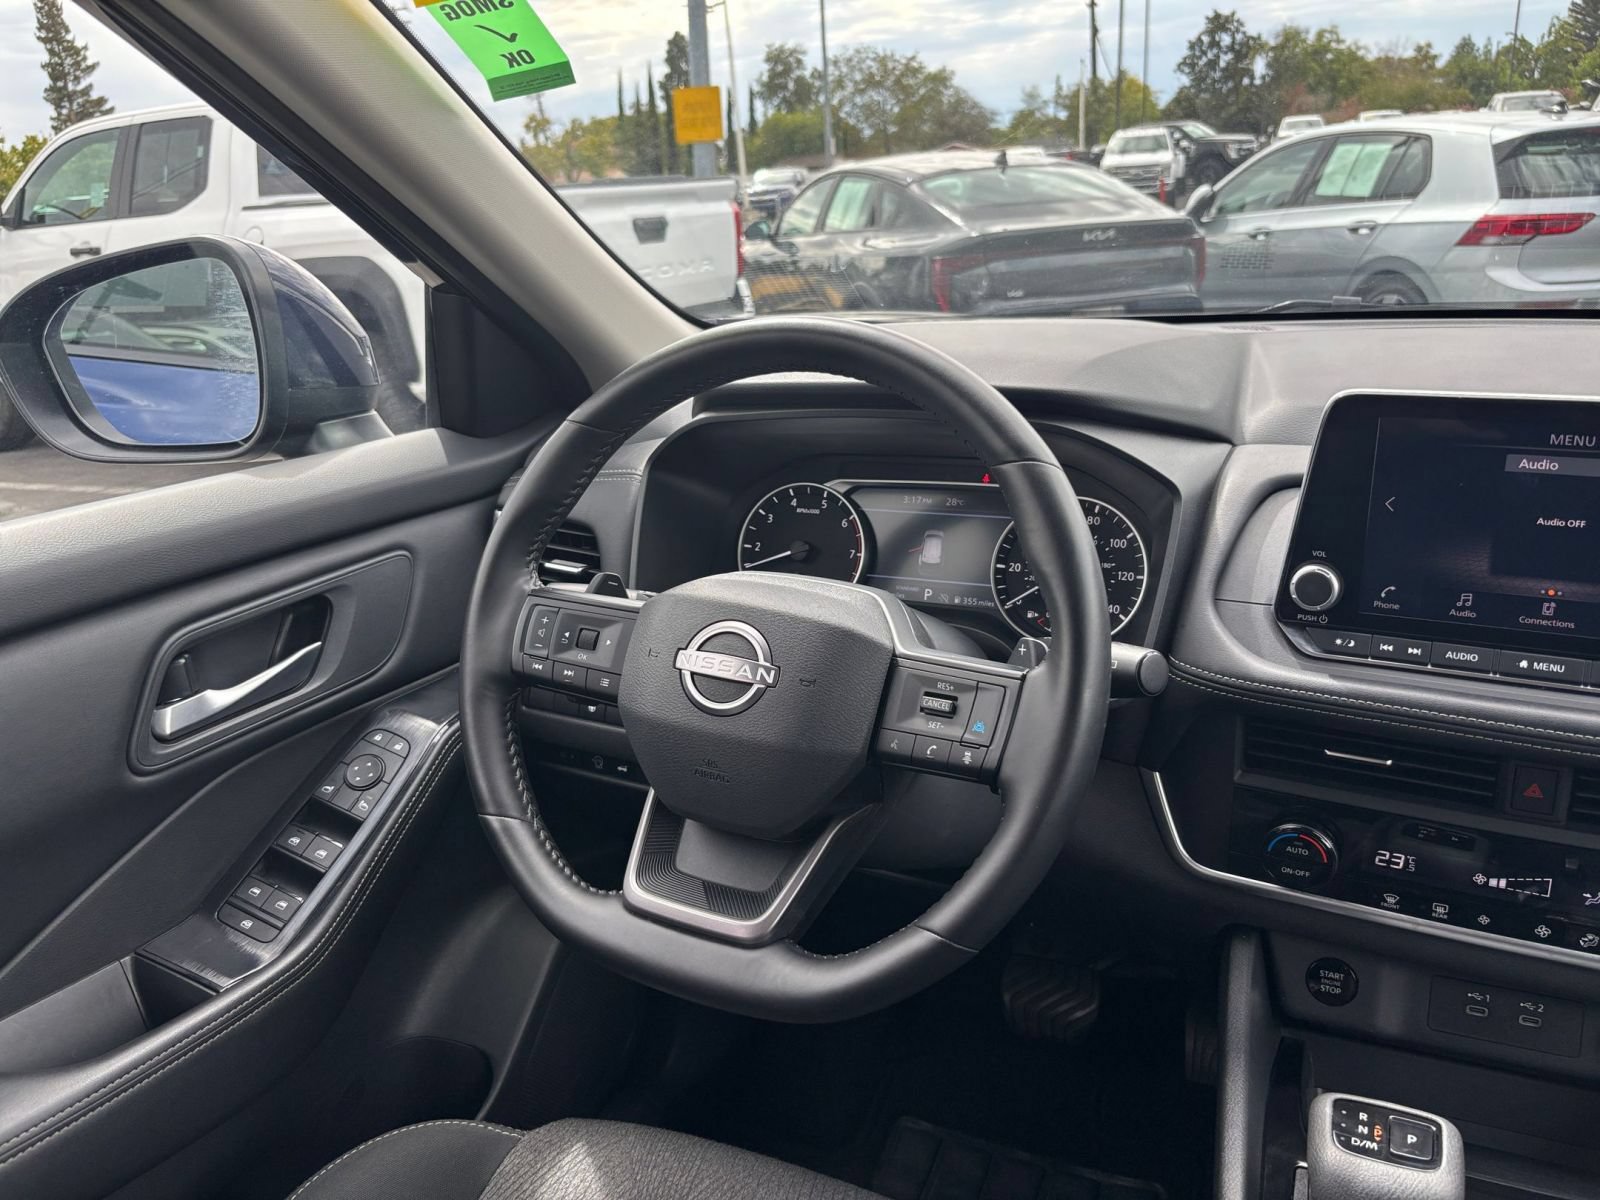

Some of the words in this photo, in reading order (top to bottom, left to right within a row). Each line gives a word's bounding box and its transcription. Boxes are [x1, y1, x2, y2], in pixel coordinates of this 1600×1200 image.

[1549, 433, 1596, 447] MENU
[1518, 458, 1560, 471] Audio
[790, 498, 797, 507] 4
[821, 499, 828, 509] 5
[767, 513, 774, 523] 3
[841, 518, 848, 528] 6
[1087, 515, 1101, 526] 80
[1536, 517, 1566, 527] Audio
[1567, 519, 1587, 528] OFF
[754, 542, 761, 552] 2
[1110, 538, 1128, 549] 100
[849, 549, 856, 559] 7
[1008, 562, 1021, 572] 20
[1118, 571, 1135, 582] 120
[924, 588, 933, 601] P
[1373, 600, 1400, 610] Phone
[1297, 613, 1318, 622] PUSH
[1449, 608, 1477, 618] Audio
[1518, 616, 1575, 629] Connections
[1445, 650, 1479, 662] AUDIO
[678, 651, 776, 684] NISSAN
[1533, 661, 1565, 673] MENU
[922, 698, 950, 712] CANCEL
[1286, 846, 1309, 856] AUTO
[1281, 866, 1311, 878] ON-OFF
[1320, 969, 1345, 981] START
[1320, 984, 1342, 994] STOP
[1538, 1003, 1544, 1013] 2
[1359, 1112, 1368, 1122] R
[1358, 1125, 1368, 1135] N
[1351, 1137, 1378, 1151] D/M
[1406, 1134, 1417, 1145] P
